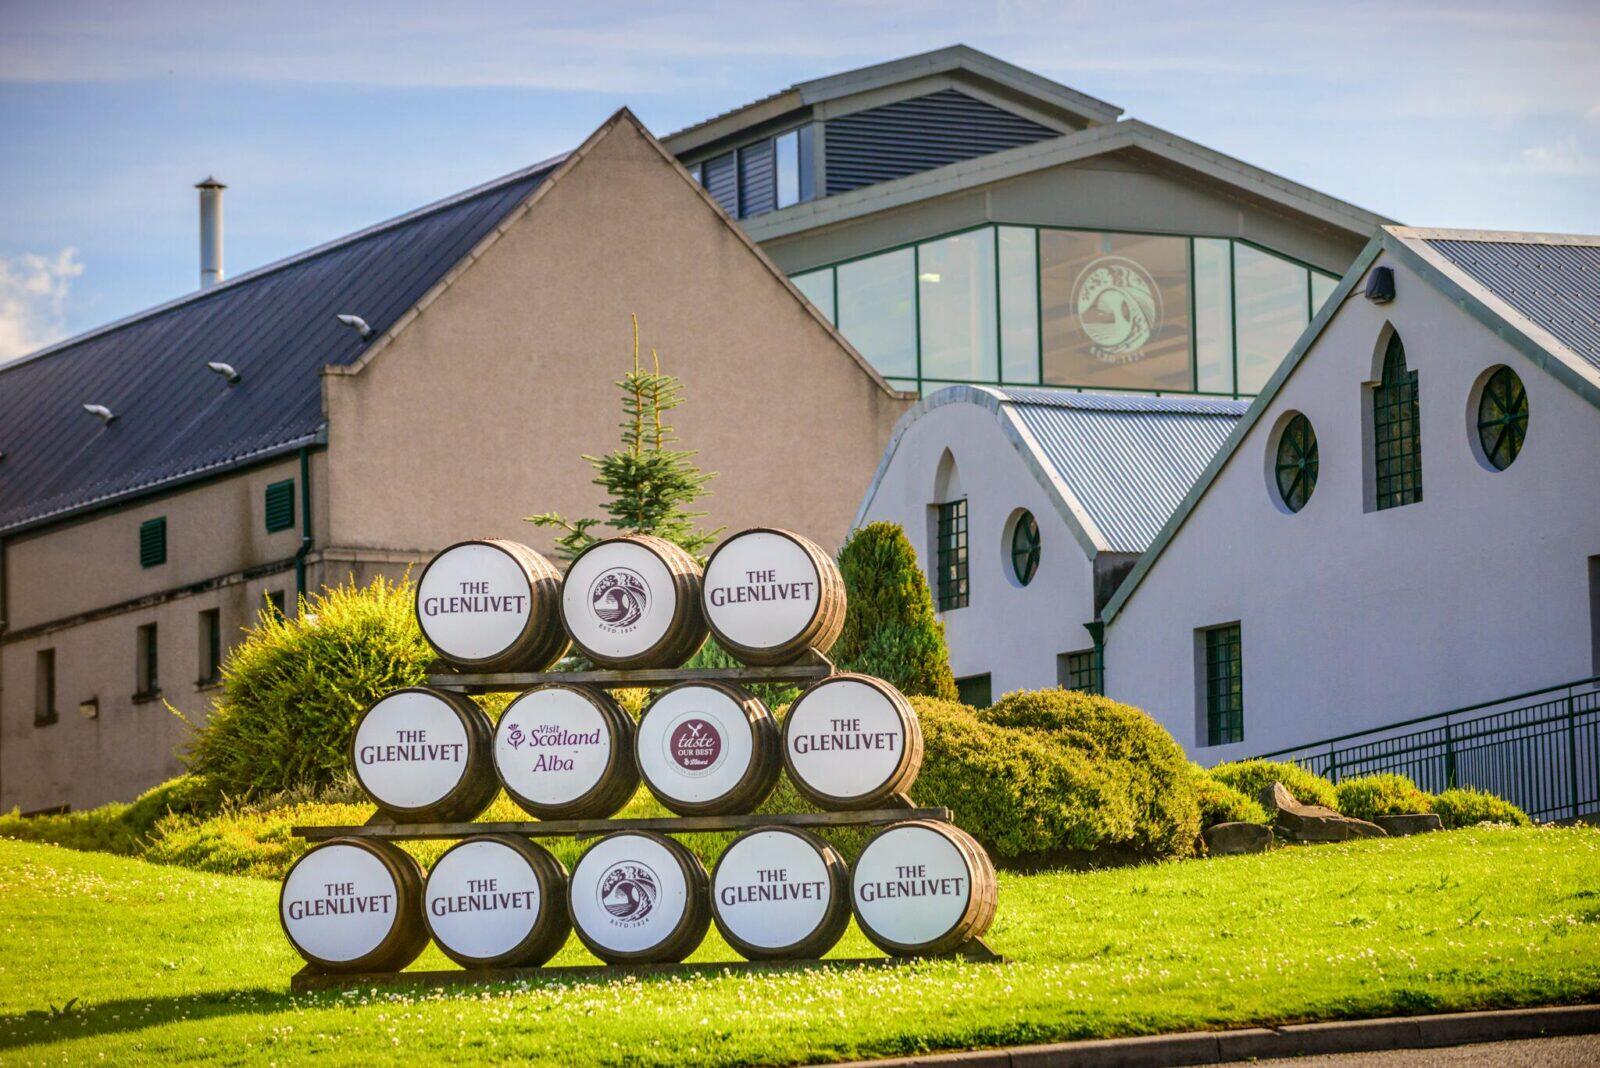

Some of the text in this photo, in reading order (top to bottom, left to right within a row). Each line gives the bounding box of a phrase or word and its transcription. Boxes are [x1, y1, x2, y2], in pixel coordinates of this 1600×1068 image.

[745, 569, 776, 584] THE
[459, 581, 489, 595] THE
[710, 581, 814, 607] GLENLIVET
[423, 595, 526, 617] GLENLIVET
[539, 724, 560, 735] Visit
[830, 718, 861, 732] THE
[396, 729, 426, 744] THE
[529, 728, 601, 748] Scotland
[678, 733, 715, 748] taste
[793, 732, 898, 754] GLENLIVET
[360, 743, 463, 765] GLENLIVET
[695, 748, 713, 756] BEST
[532, 753, 574, 773] Alba
[756, 868, 788, 883] THE
[895, 864, 926, 879] THE
[324, 882, 355, 897] THE
[466, 878, 498, 893] THE
[859, 877, 964, 903] GLENLIVET
[720, 881, 825, 907] GLENLIVET
[288, 894, 392, 921] GLENLIVET
[431, 890, 535, 917] GLENLIVET
